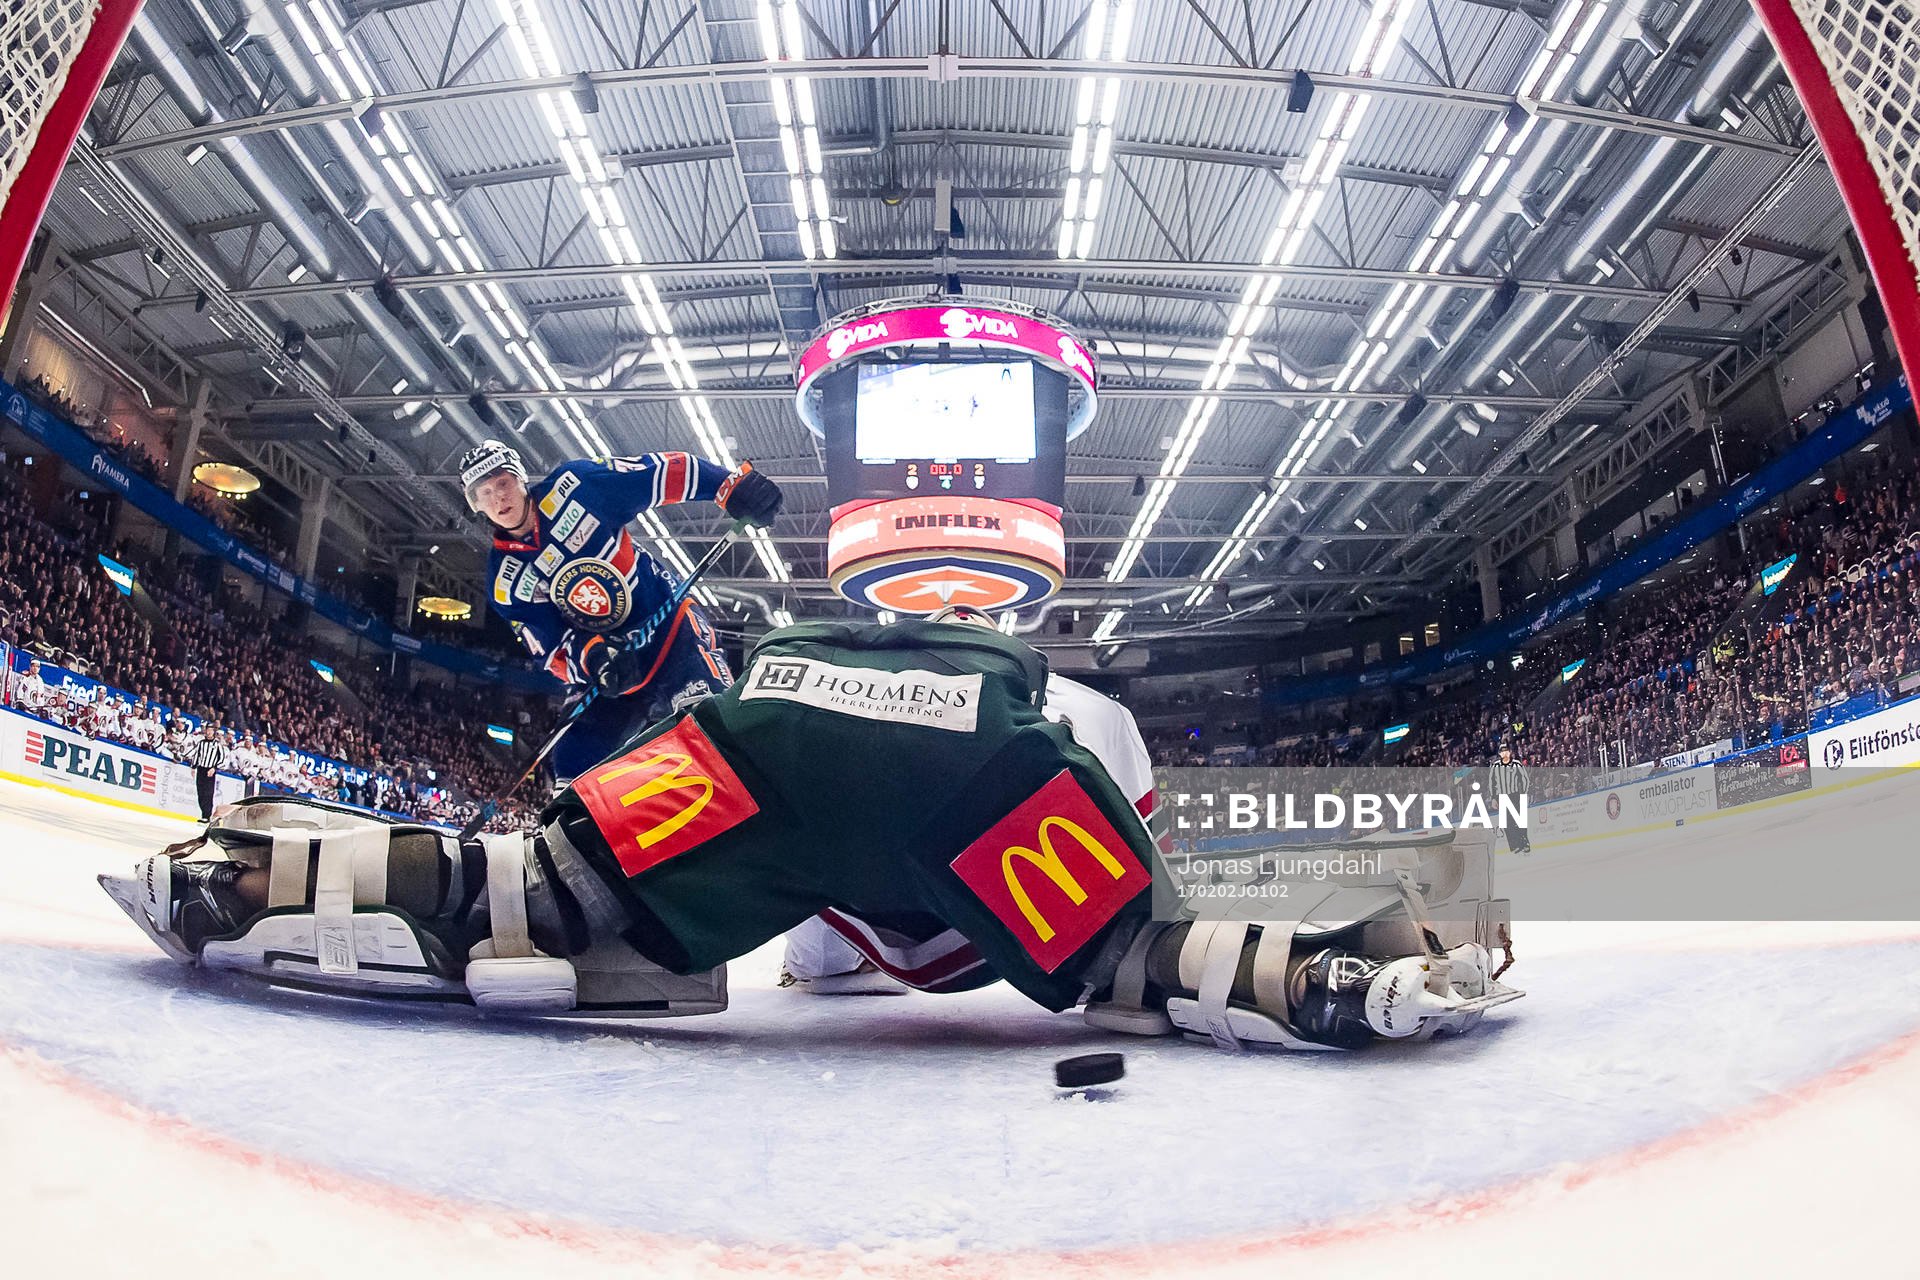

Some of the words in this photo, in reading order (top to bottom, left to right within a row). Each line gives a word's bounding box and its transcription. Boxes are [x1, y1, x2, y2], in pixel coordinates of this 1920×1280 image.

[850, 321, 889, 343] VIDA
[969, 315, 1018, 338] VIDA
[907, 463, 918, 476] 2
[974, 463, 985, 476] 2
[557, 475, 576, 498] put
[557, 508, 580, 537] wilo
[896, 514, 1001, 530] UNIFLEX
[502, 559, 519, 582] put
[557, 567, 579, 597] LAKERS
[580, 564, 613, 580] HOCKEY
[813, 674, 968, 708] HOLMENS
[830, 696, 944, 718] HERREKIPERING
[40, 735, 142, 791] PEAB
[1780, 745, 1799, 764] ICA
[1639, 776, 1696, 799] emballator
